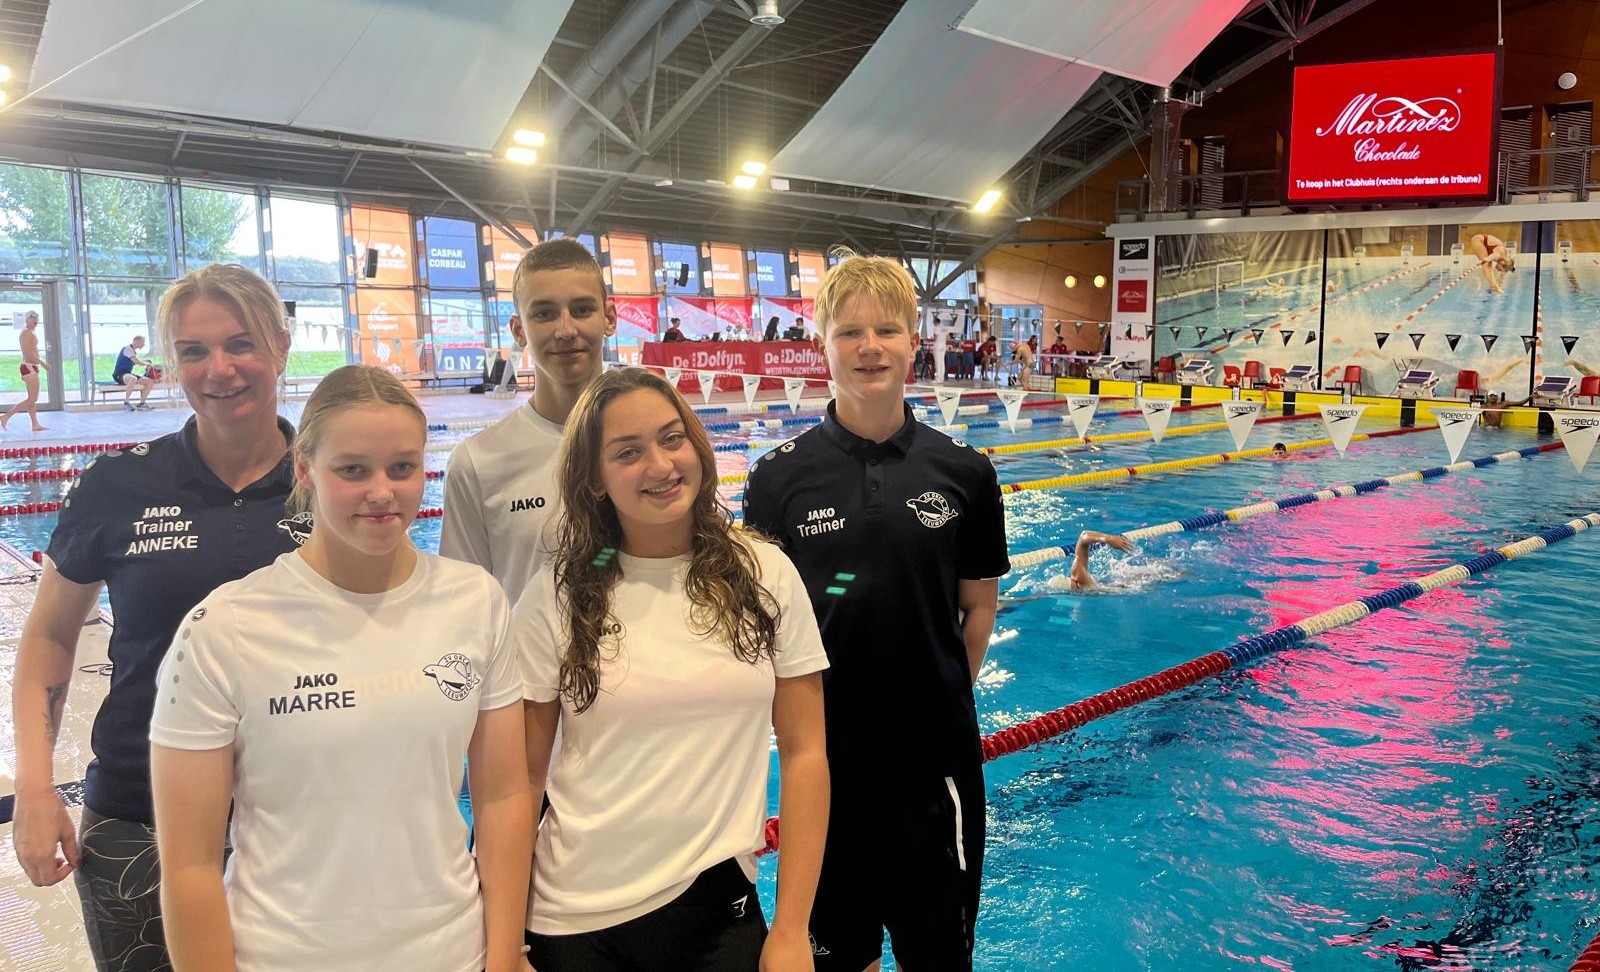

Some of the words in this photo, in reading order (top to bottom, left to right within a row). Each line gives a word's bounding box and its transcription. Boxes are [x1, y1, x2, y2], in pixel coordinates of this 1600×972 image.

[1354, 137, 1421, 162] Chocolade
[1296, 179, 1305, 188] Te
[1306, 180, 1323, 189] koop
[1324, 178, 1331, 187] in
[1332, 178, 1344, 187] het
[1345, 177, 1375, 187] Clubhuis
[1376, 176, 1403, 187] (rechts
[1403, 176, 1438, 185] onderaan
[1440, 175, 1449, 184] de
[1450, 173, 1482, 184] tribune)
[431, 248, 463, 258] CASPAR
[429, 258, 466, 269] CORBEAU
[764, 352, 780, 365] De
[1144, 401, 1170, 410] speedo
[1228, 404, 1257, 414] speedo
[1326, 408, 1358, 418] speedo
[1440, 411, 1473, 421] speedo
[1560, 416, 1600, 427] speedo
[510, 496, 546, 513] JAKO
[142, 505, 182, 519] JAKO
[806, 507, 836, 522] JAKO
[132, 519, 192, 536] Trainer
[797, 517, 846, 538] Trainer
[125, 535, 199, 556] ANNEKE
[293, 672, 338, 690] JAKO
[269, 690, 356, 715] MARRE
